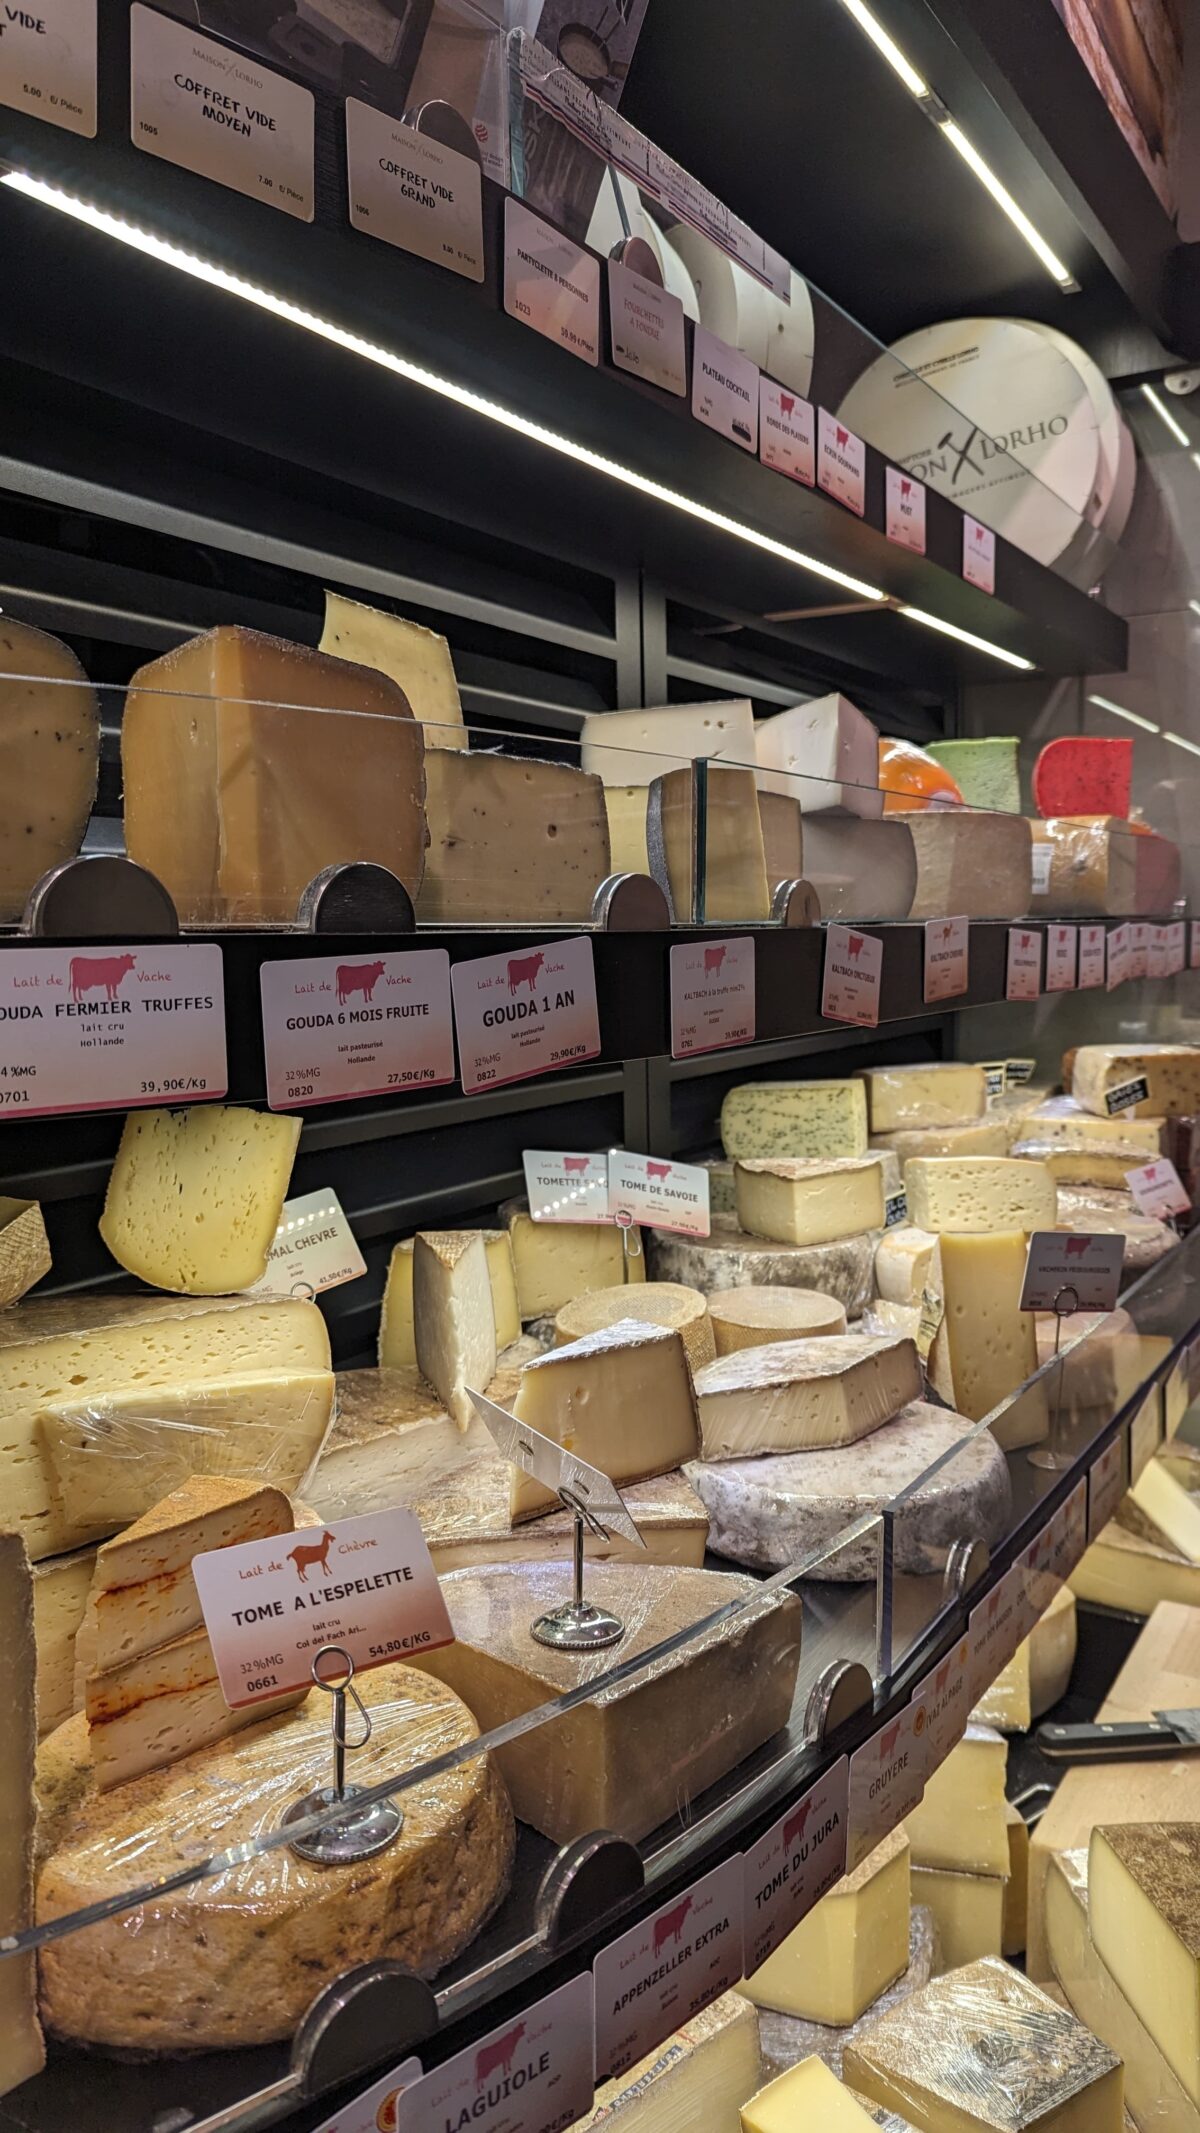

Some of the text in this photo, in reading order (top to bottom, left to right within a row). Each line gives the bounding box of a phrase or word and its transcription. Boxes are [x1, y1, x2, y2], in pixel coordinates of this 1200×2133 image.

[5, 5, 46, 34] VIDE
[192, 48, 226, 70] MAISON
[174, 73, 277, 131] COFFRET VIDE
[202, 104, 251, 137] MOYEN
[378, 158, 454, 203] COFFRET VIDE
[400, 184, 435, 208] GRAND
[517, 248, 553, 279] PARTYCLETTE
[559, 276, 589, 304] PERSONNES
[515, 299, 531, 316] 1023
[702, 362, 750, 403] PLATEAU COCKTAIL
[979, 415, 1068, 461] LORHO
[13, 970, 172, 989] Lait de Vache
[295, 975, 412, 994] Lait de Vache
[477, 963, 565, 990] Lait de Vache
[684, 988, 708, 1001] KALTBACH
[55, 1001, 131, 1017] FERMIER
[142, 997, 213, 1013] TRUFFES
[286, 1003, 429, 1031] GOUDA 6 MOIS FRUITE
[482, 989, 575, 1028] GOUDA 1 AN
[80, 1023, 124, 1033] lait cru
[80, 1037, 124, 1048] Hollande
[350, 1040, 383, 1053] pasteurisé
[550, 1044, 586, 1061] 29,90€/Kg
[347, 1055, 376, 1065] Hollande
[140, 1078, 207, 1093] 39,90€/Kg
[387, 1069, 435, 1083] 27,50€/Kg
[477, 1069, 496, 1082] 0822
[287, 1085, 313, 1098] 0820
[536, 1176, 580, 1188] TOMETTE
[620, 1178, 647, 1192] TOME
[649, 1185, 662, 1196] DE
[664, 1188, 698, 1203] SAVOIE
[294, 1226, 339, 1250] CHEVRE
[238, 1538, 378, 1580] Lait de Chèvre
[232, 1566, 414, 1627] TOME A L'ESPELETTE
[312, 1618, 341, 1631] lait cru
[296, 1639, 310, 1650] Col
[311, 1634, 325, 1646] del
[368, 1631, 431, 1659] 54,80€/KG
[246, 1674, 279, 1692] 0661
[868, 1751, 909, 1800] GRUYERE
[754, 1863, 790, 1910] TOME
[792, 1843, 810, 1872] DU
[811, 1811, 840, 1853] JURA
[612, 1945, 693, 2016] APPENZELLER
[694, 1918, 730, 1951] EXTRA
[445, 2051, 550, 2133] LAGUIOLE
